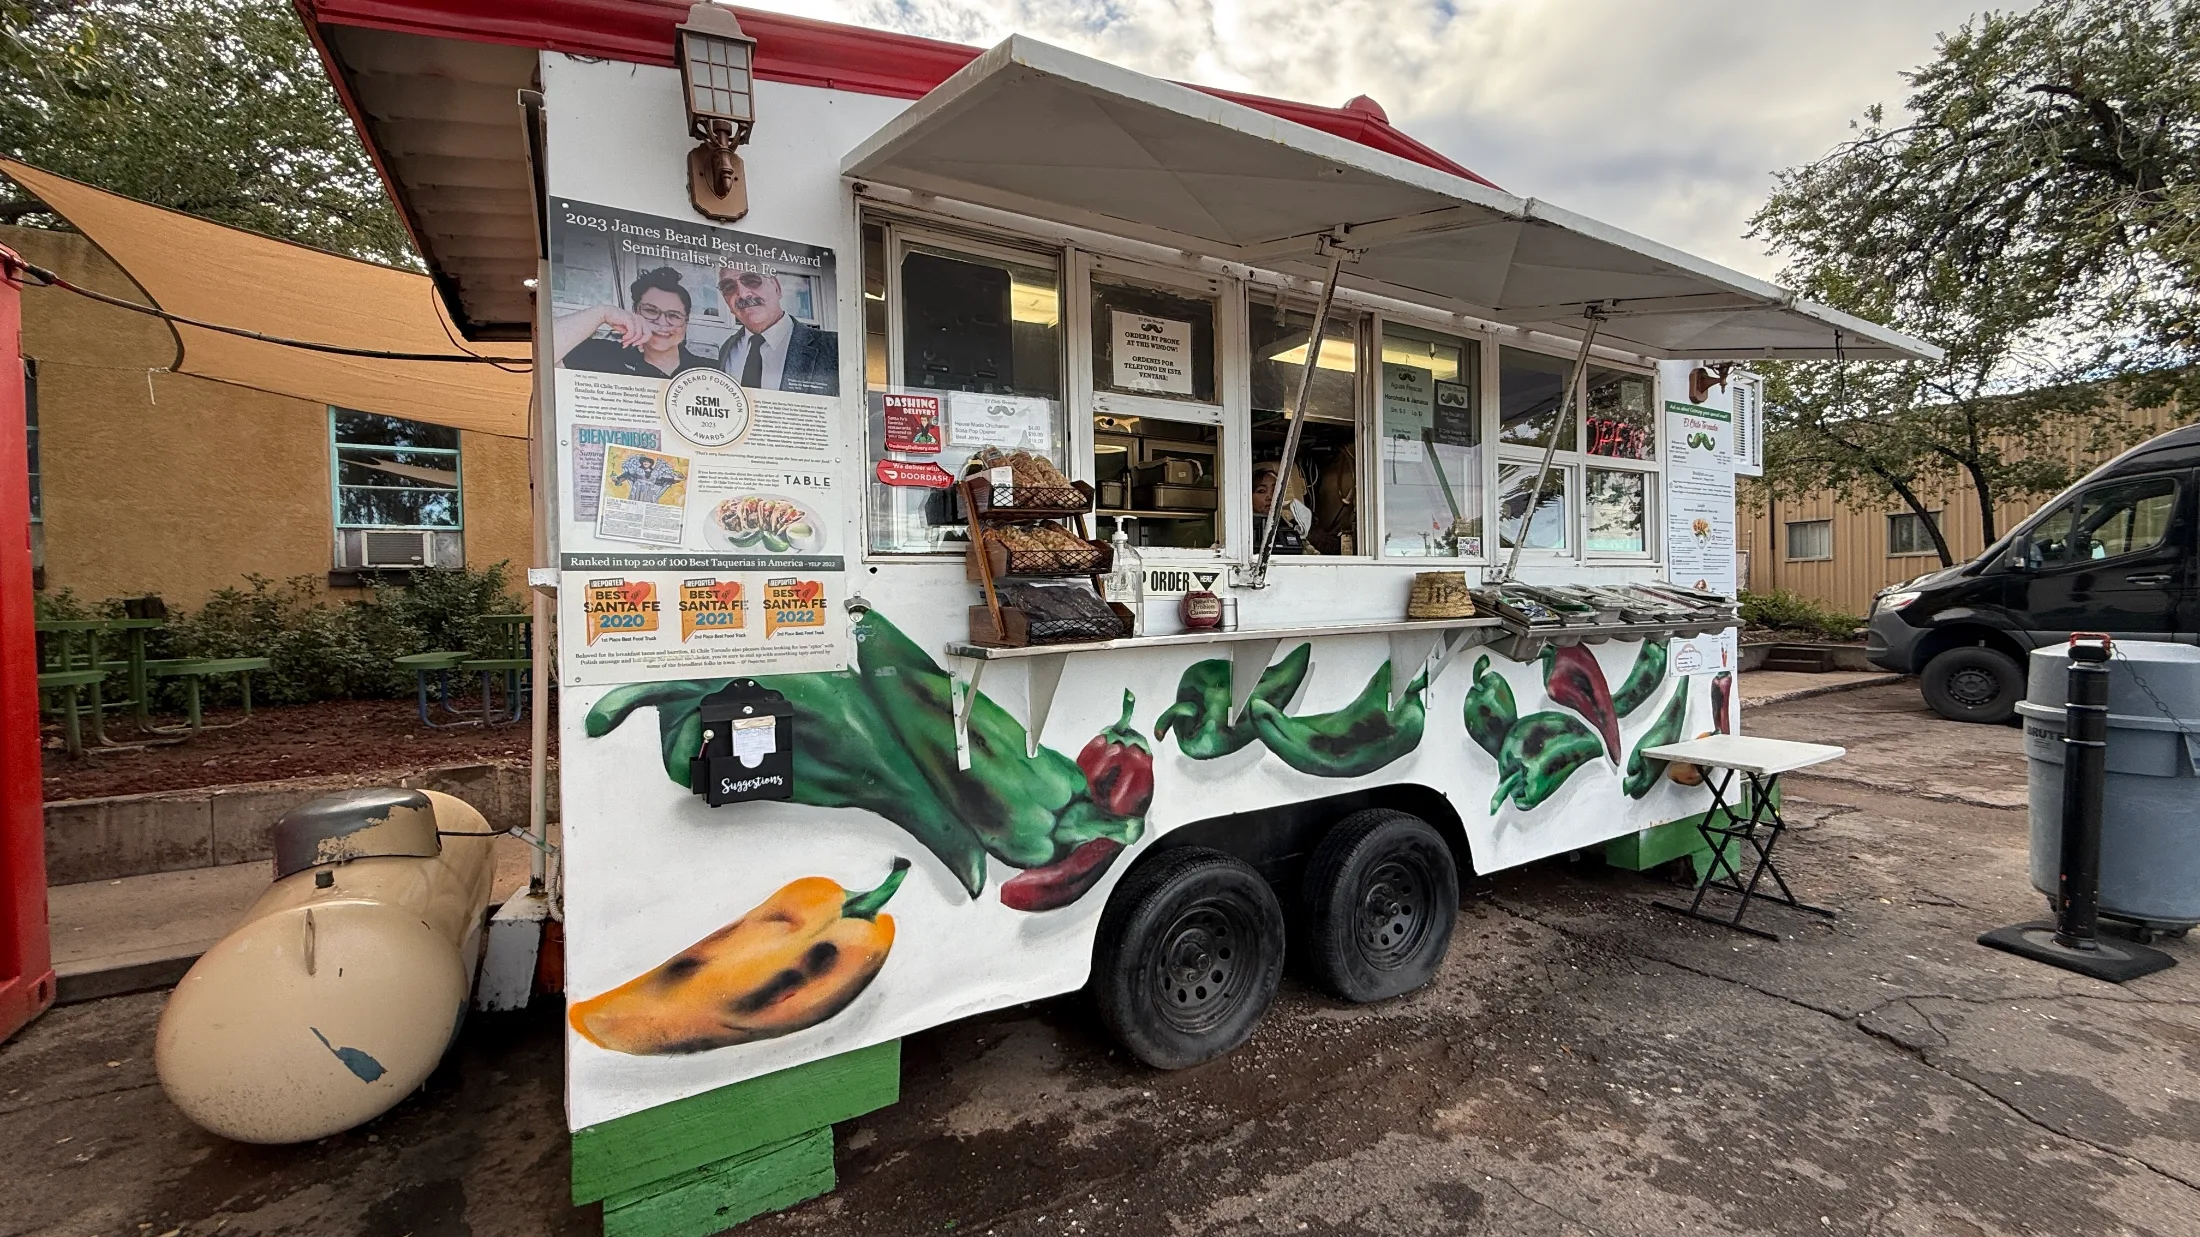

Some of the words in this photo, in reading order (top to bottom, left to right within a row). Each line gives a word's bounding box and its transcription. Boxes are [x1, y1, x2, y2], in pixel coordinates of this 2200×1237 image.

[566, 212, 608, 232] 2023
[611, 218, 660, 239] James
[664, 228, 707, 248] Beard
[711, 237, 741, 254] Best
[744, 242, 777, 261] Chef
[779, 250, 822, 268] Award
[622, 240, 715, 268] Semifinalist,
[718, 256, 758, 274] Santa
[762, 263, 777, 277] Fe
[1125, 332, 1150, 340] ORDERS
[1160, 336, 1180, 345] PHONE
[1132, 356, 1160, 364] ORDENES
[1124, 362, 1157, 372] TELEFONO
[672, 384, 684, 408] JAMES
[682, 374, 707, 386] BEARD
[710, 376, 743, 413] FOUNDATION
[1385, 394, 1406, 402] Horchata
[695, 396, 720, 407] SEMI
[885, 396, 936, 409] DASHING
[686, 406, 730, 418] FINALIST
[903, 408, 936, 416] DELIVERY
[1683, 418, 1689, 427] El
[1690, 418, 1701, 428] Chile
[580, 428, 656, 448] BIENVENIDOS
[693, 432, 724, 440] AWARDS
[888, 443, 939, 451] DashingDelivery.com
[784, 475, 831, 486] TABLE
[901, 472, 948, 482] DOORDASH
[570, 557, 609, 566] Ranked
[613, 557, 622, 566] in
[624, 558, 640, 568] top
[657, 558, 667, 566] of
[690, 558, 709, 566] Best
[710, 558, 754, 569] Taquerias
[593, 578, 624, 587] REPORTER
[686, 578, 715, 587] REPORTER
[1151, 570, 1190, 592] ORDER
[596, 591, 629, 600] BEST
[690, 590, 720, 599] BEST
[584, 601, 638, 613] SANTA
[642, 601, 661, 612] FE
[679, 601, 728, 611] SANTA
[732, 600, 749, 610] FE
[763, 599, 808, 609] SANTA
[812, 599, 827, 608] FE
[600, 614, 644, 628] 2020
[696, 612, 733, 625] 2021
[776, 610, 814, 623] 2022
[2027, 726, 2064, 741] BRUTE
[721, 775, 783, 794] Suggestions
